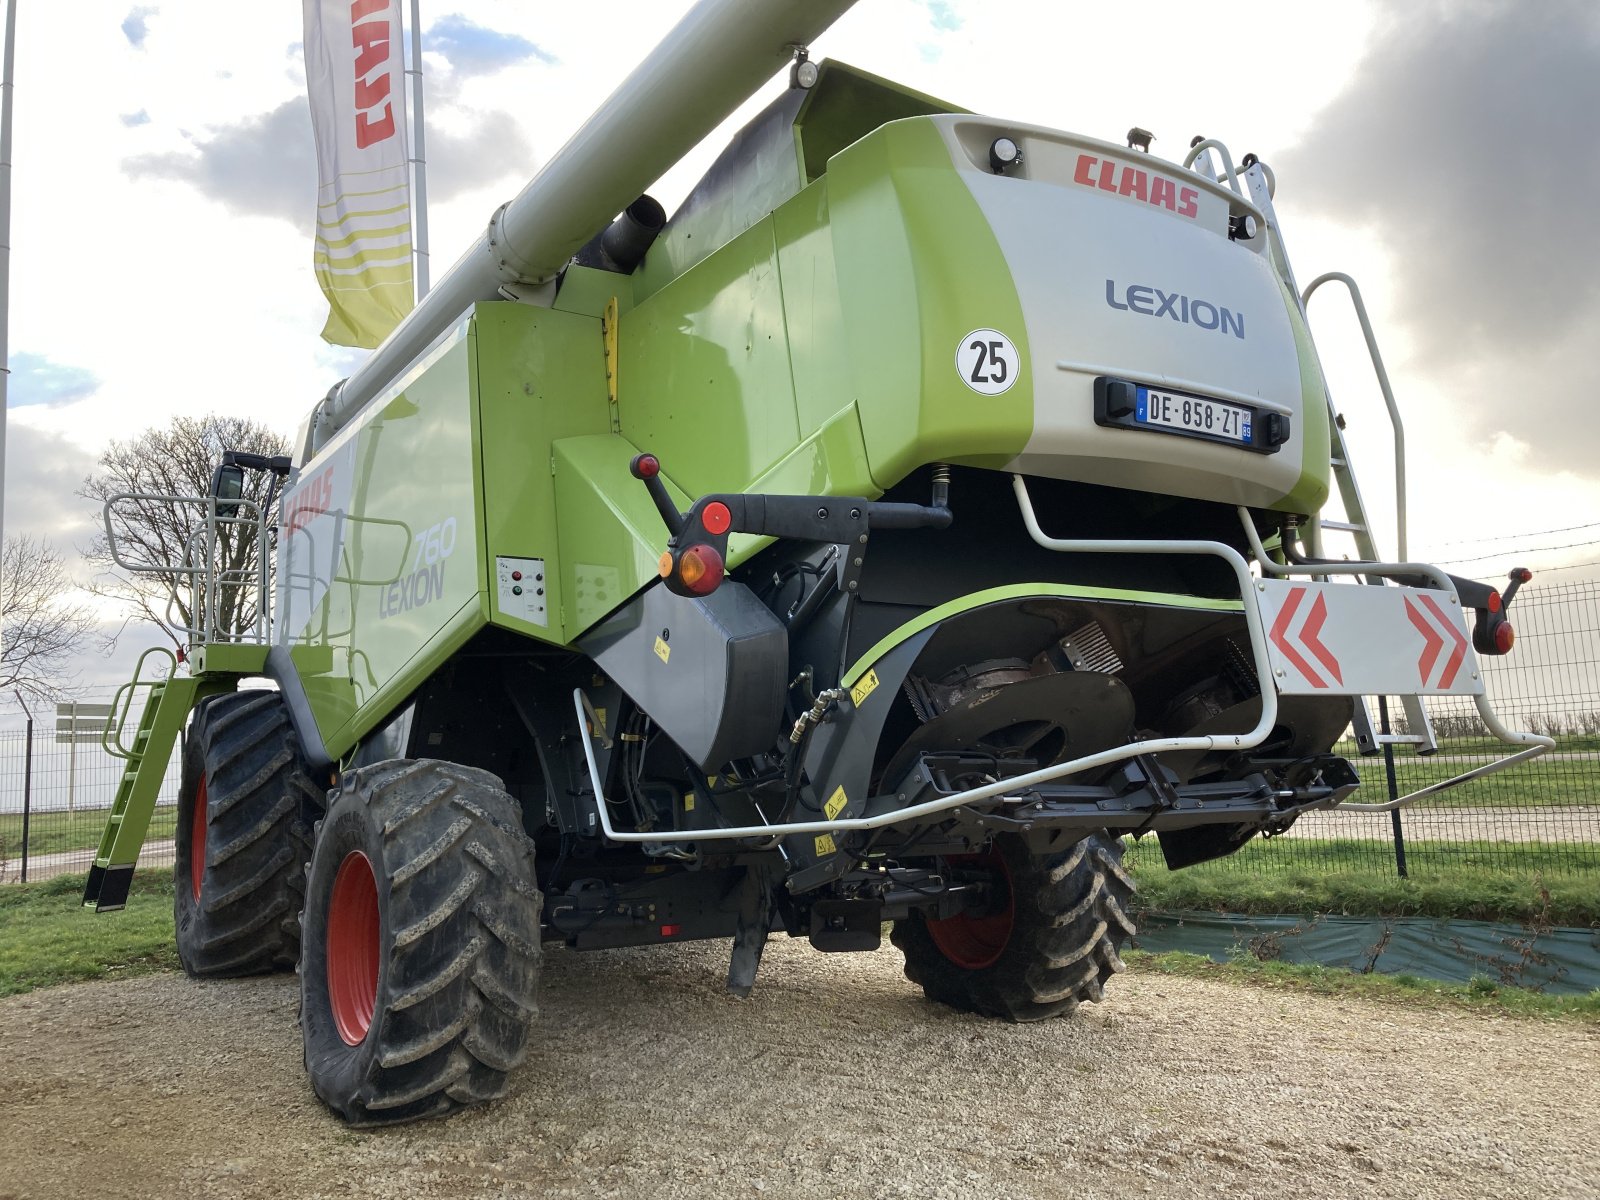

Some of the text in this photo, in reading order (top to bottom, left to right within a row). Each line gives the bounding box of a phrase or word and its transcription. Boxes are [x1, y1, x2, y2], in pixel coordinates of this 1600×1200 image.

[1074, 154, 1198, 218] CLAAS
[1106, 279, 1244, 339] LEXION
[969, 340, 1007, 383] 25
[412, 516, 457, 572] 760
[379, 559, 446, 620] LEXION
